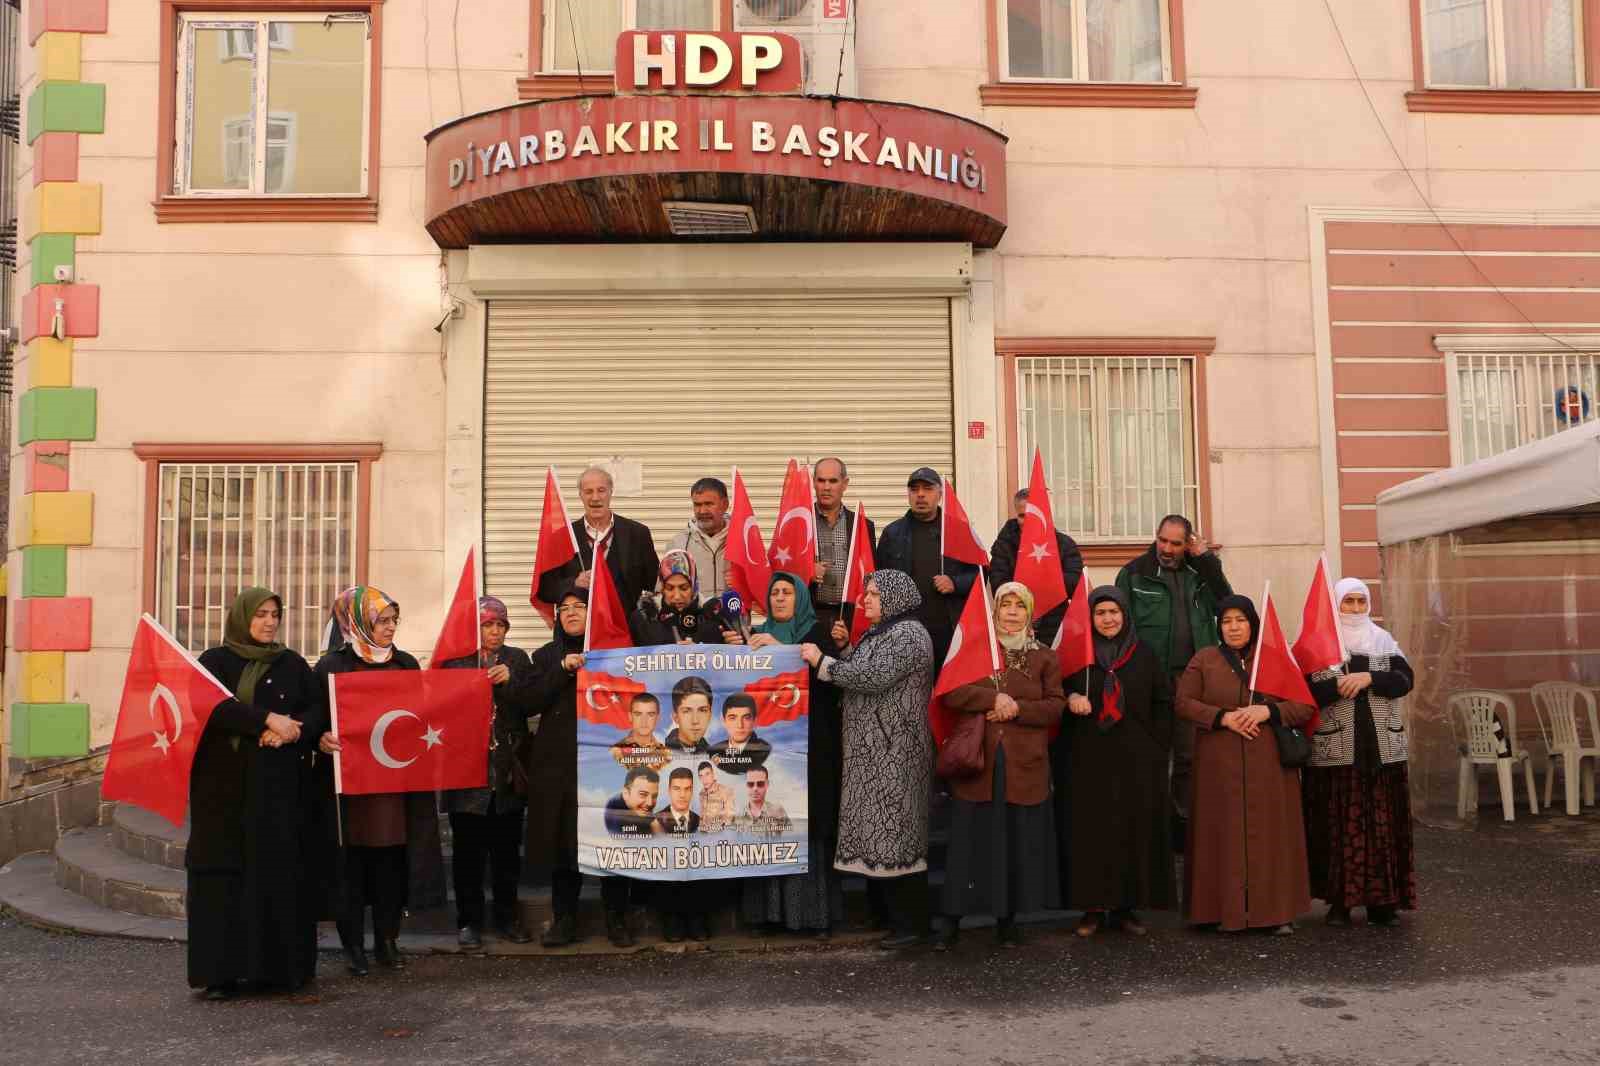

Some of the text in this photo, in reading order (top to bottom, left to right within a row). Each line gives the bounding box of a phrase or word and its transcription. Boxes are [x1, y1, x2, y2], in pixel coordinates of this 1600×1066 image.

[633, 33, 783, 87] HDP
[449, 119, 681, 188] DİYARBAKIR
[751, 120, 987, 193] BAŞKANLIĞI
[624, 651, 774, 676] ŞEHİTLER ÖLMEZ
[595, 841, 800, 870] VATAN BÖLÜNMEZ
